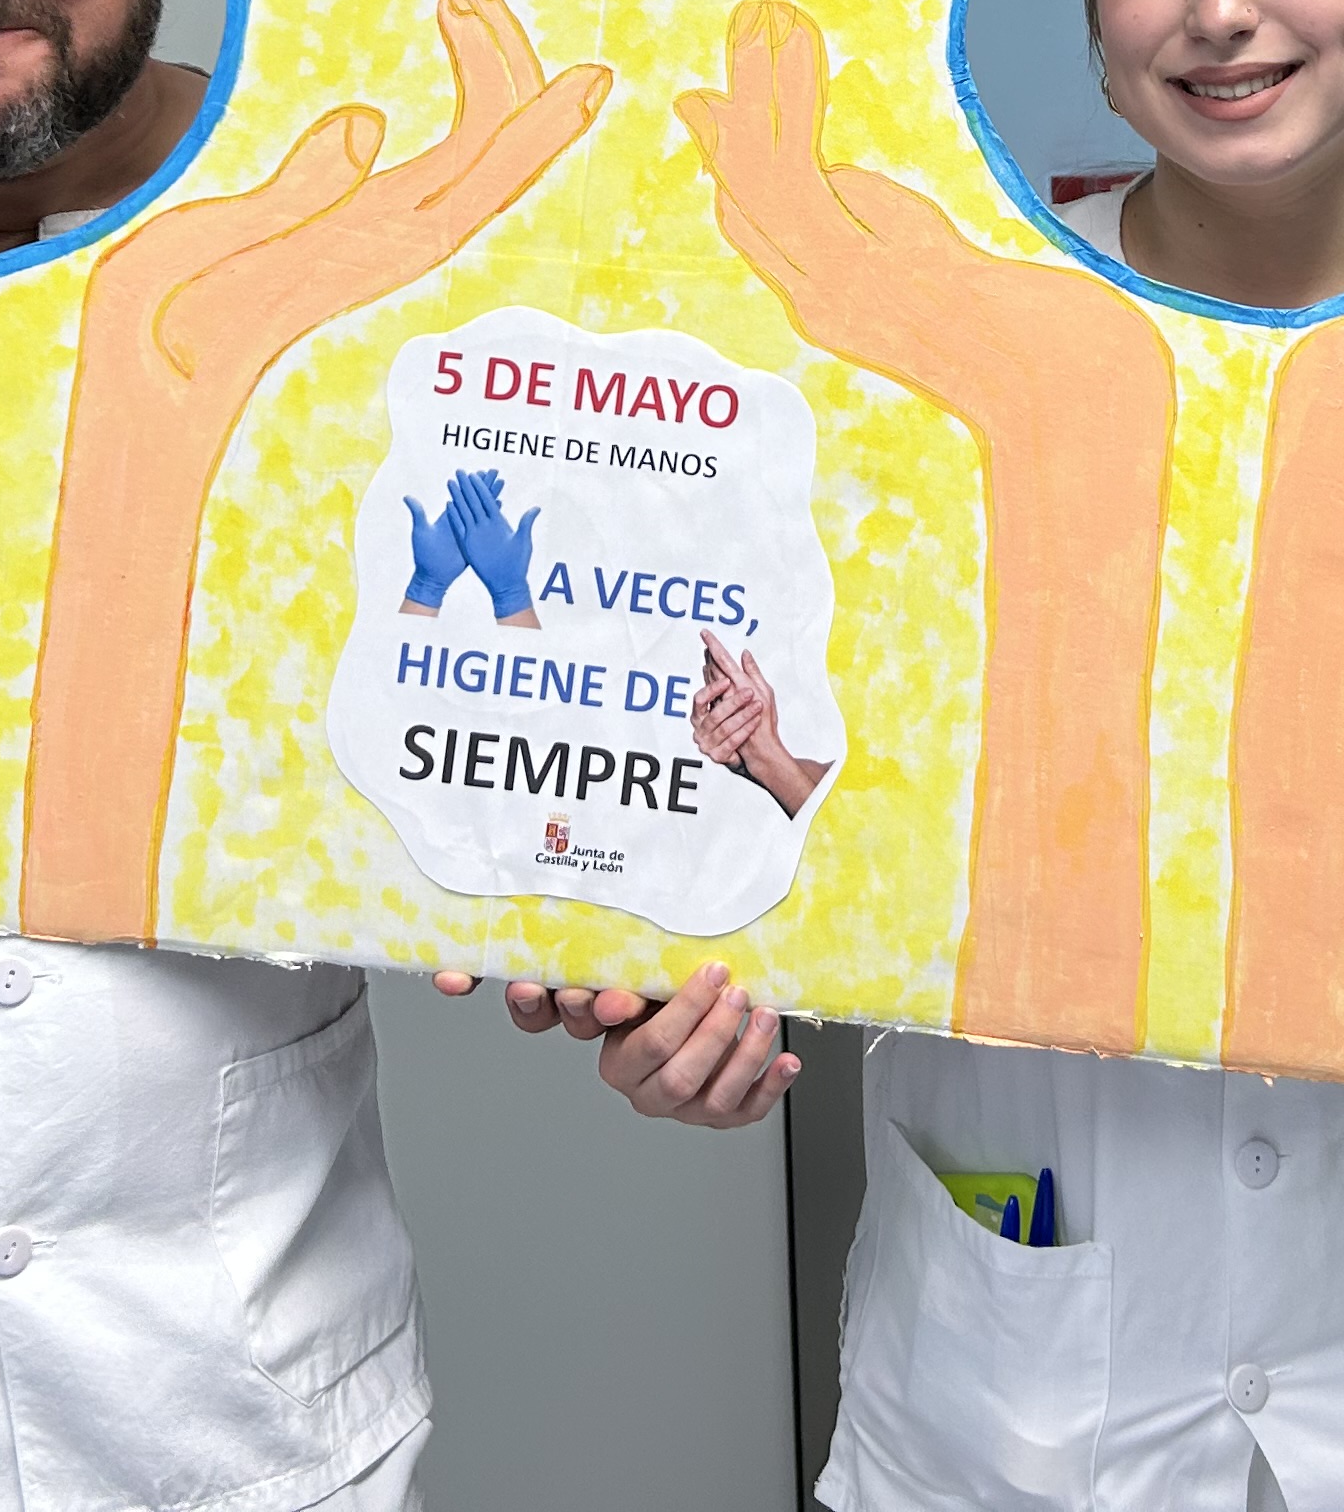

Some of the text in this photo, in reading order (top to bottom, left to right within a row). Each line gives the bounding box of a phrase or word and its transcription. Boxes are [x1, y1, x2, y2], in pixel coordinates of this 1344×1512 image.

[433, 351, 740, 429] 5 DE MAYO
[441, 423, 719, 480] HIGIENE DE MANOS
[538, 561, 760, 637] A VECES,
[396, 642, 692, 720] HIGIENE DE
[398, 723, 704, 815] SIEMPRE
[535, 852, 623, 874] Castilla y León
[570, 844, 625, 861] Junta de
